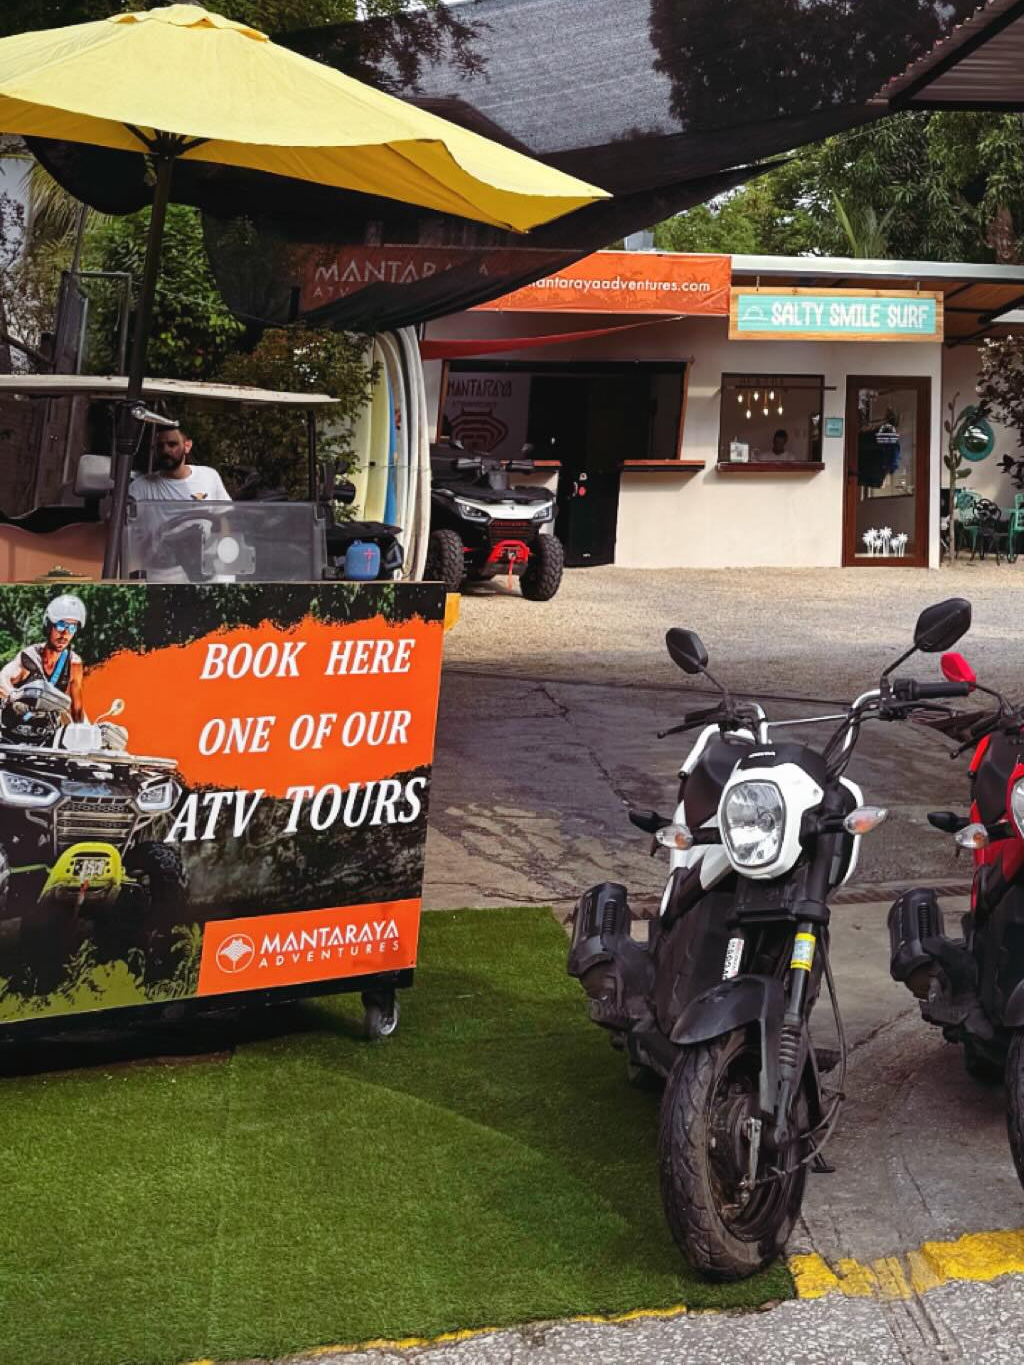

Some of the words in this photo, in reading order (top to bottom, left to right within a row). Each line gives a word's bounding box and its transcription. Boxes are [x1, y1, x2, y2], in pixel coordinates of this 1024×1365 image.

[771, 301, 824, 326] SALTY
[829, 302, 881, 328] SMILE
[887, 304, 930, 329] SURF
[200, 640, 306, 680] BOOK
[324, 638, 416, 676] HERE
[198, 716, 275, 756] ONE
[290, 712, 337, 750] OF
[342, 710, 411, 747] OUR
[164, 788, 266, 844] ATV
[284, 777, 428, 835] TOURS
[259, 940, 400, 968] ADVENTURES
[260, 919, 399, 955] MANTARAYA
